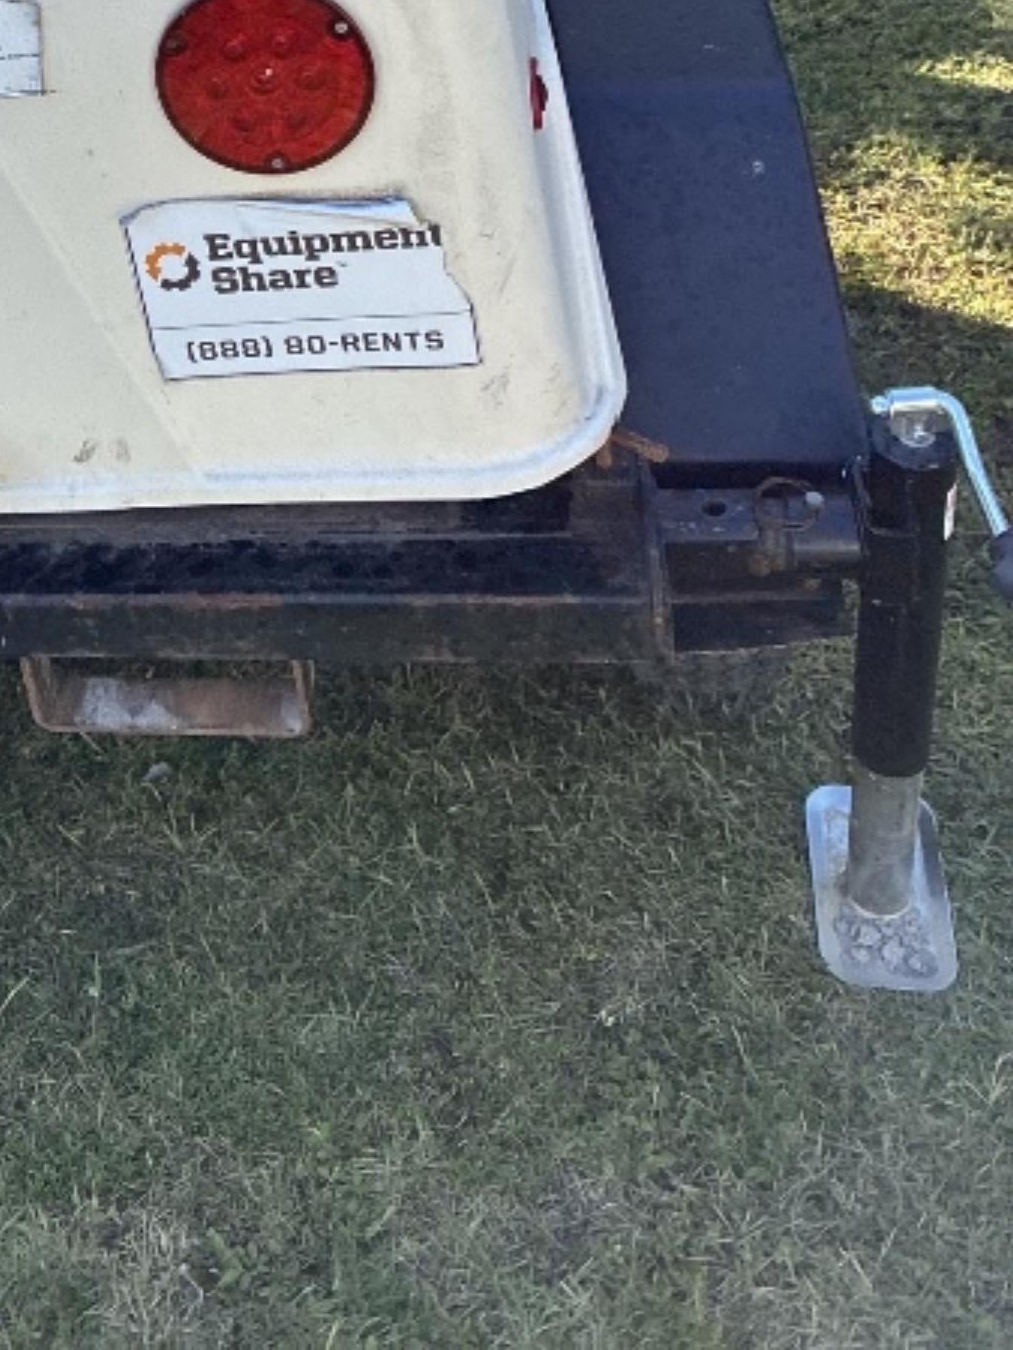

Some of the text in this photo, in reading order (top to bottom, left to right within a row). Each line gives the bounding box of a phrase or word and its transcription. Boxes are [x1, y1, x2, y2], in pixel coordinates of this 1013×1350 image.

[202, 224, 442, 264] Equipment
[210, 265, 340, 294] Share
[187, 330, 446, 364] (888) 80-RENTS
